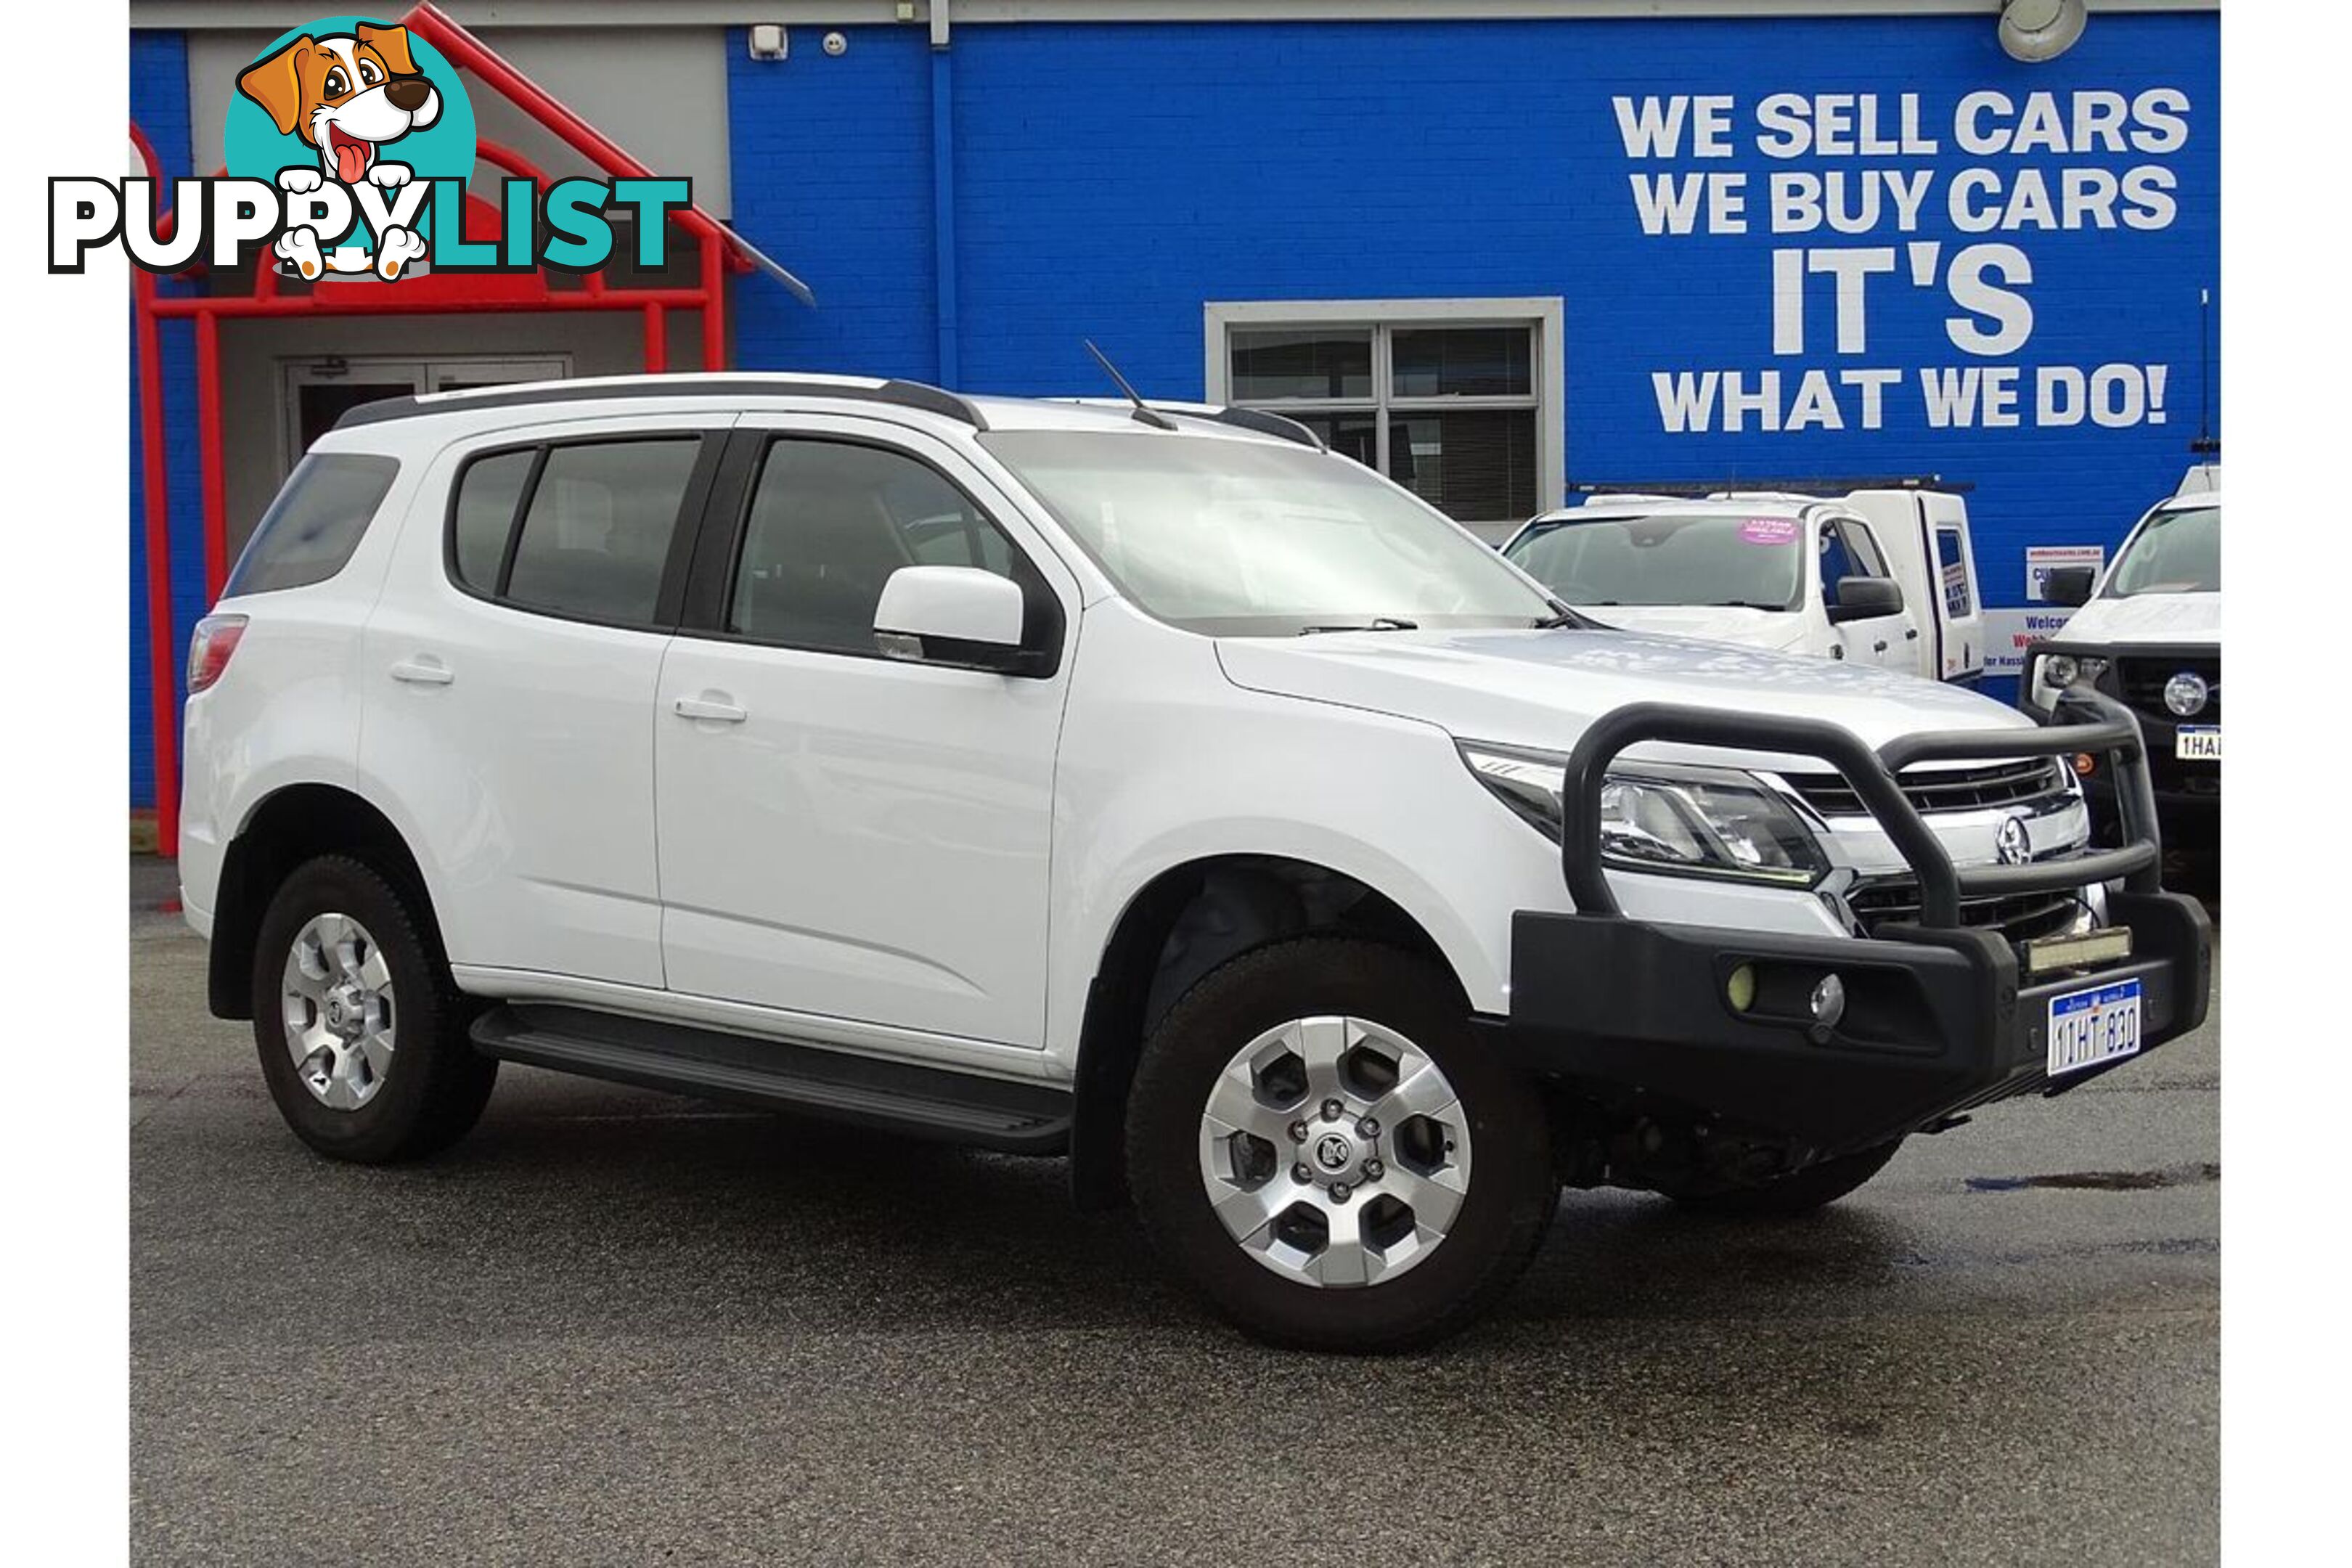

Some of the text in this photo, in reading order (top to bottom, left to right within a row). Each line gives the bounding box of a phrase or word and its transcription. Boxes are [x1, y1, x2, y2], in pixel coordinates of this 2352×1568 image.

[1612, 88, 2190, 158] WE SELL CARS
[1629, 165, 2176, 234] WE BUY CARS
[1773, 242, 2033, 355] IT'S
[1651, 364, 2168, 432] WHAT WE DO!
